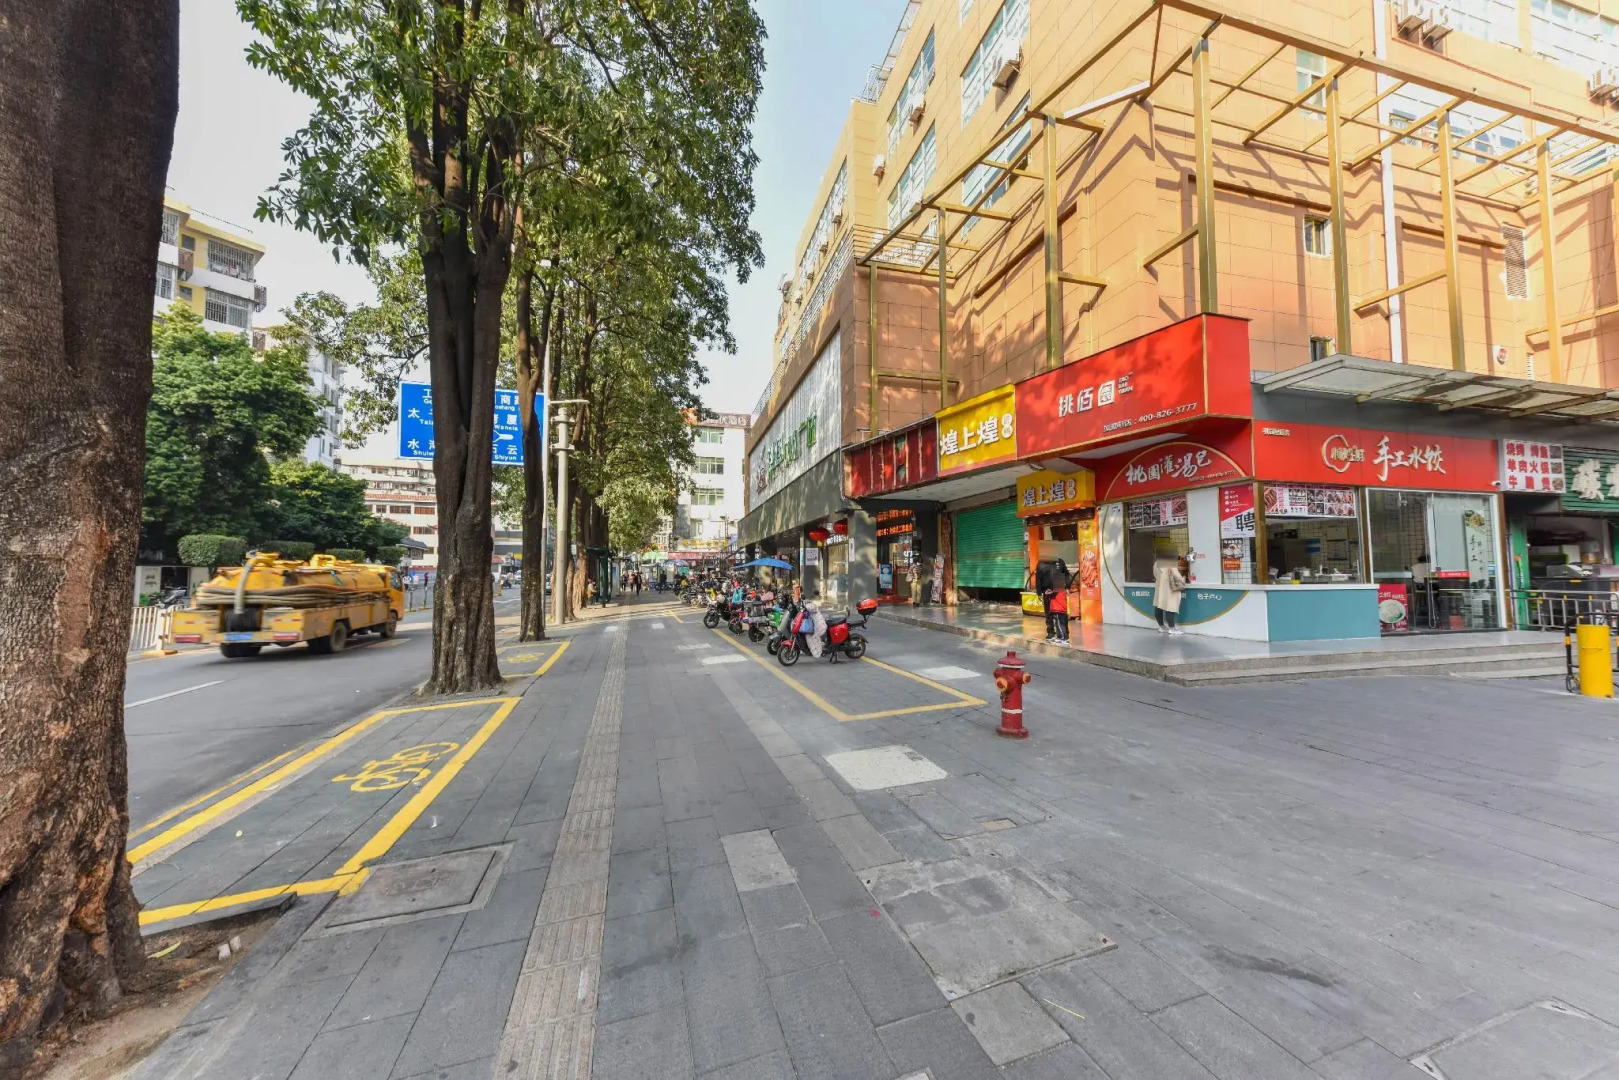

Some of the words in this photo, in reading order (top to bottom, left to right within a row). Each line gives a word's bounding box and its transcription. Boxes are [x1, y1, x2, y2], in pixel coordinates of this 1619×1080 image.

[940, 416, 999, 456] 煌上煌
[1373, 435, 1446, 482] 手工水饺
[1507, 459, 1549, 474] 羊肉火锅
[1022, 480, 1065, 507] 煌上煌
